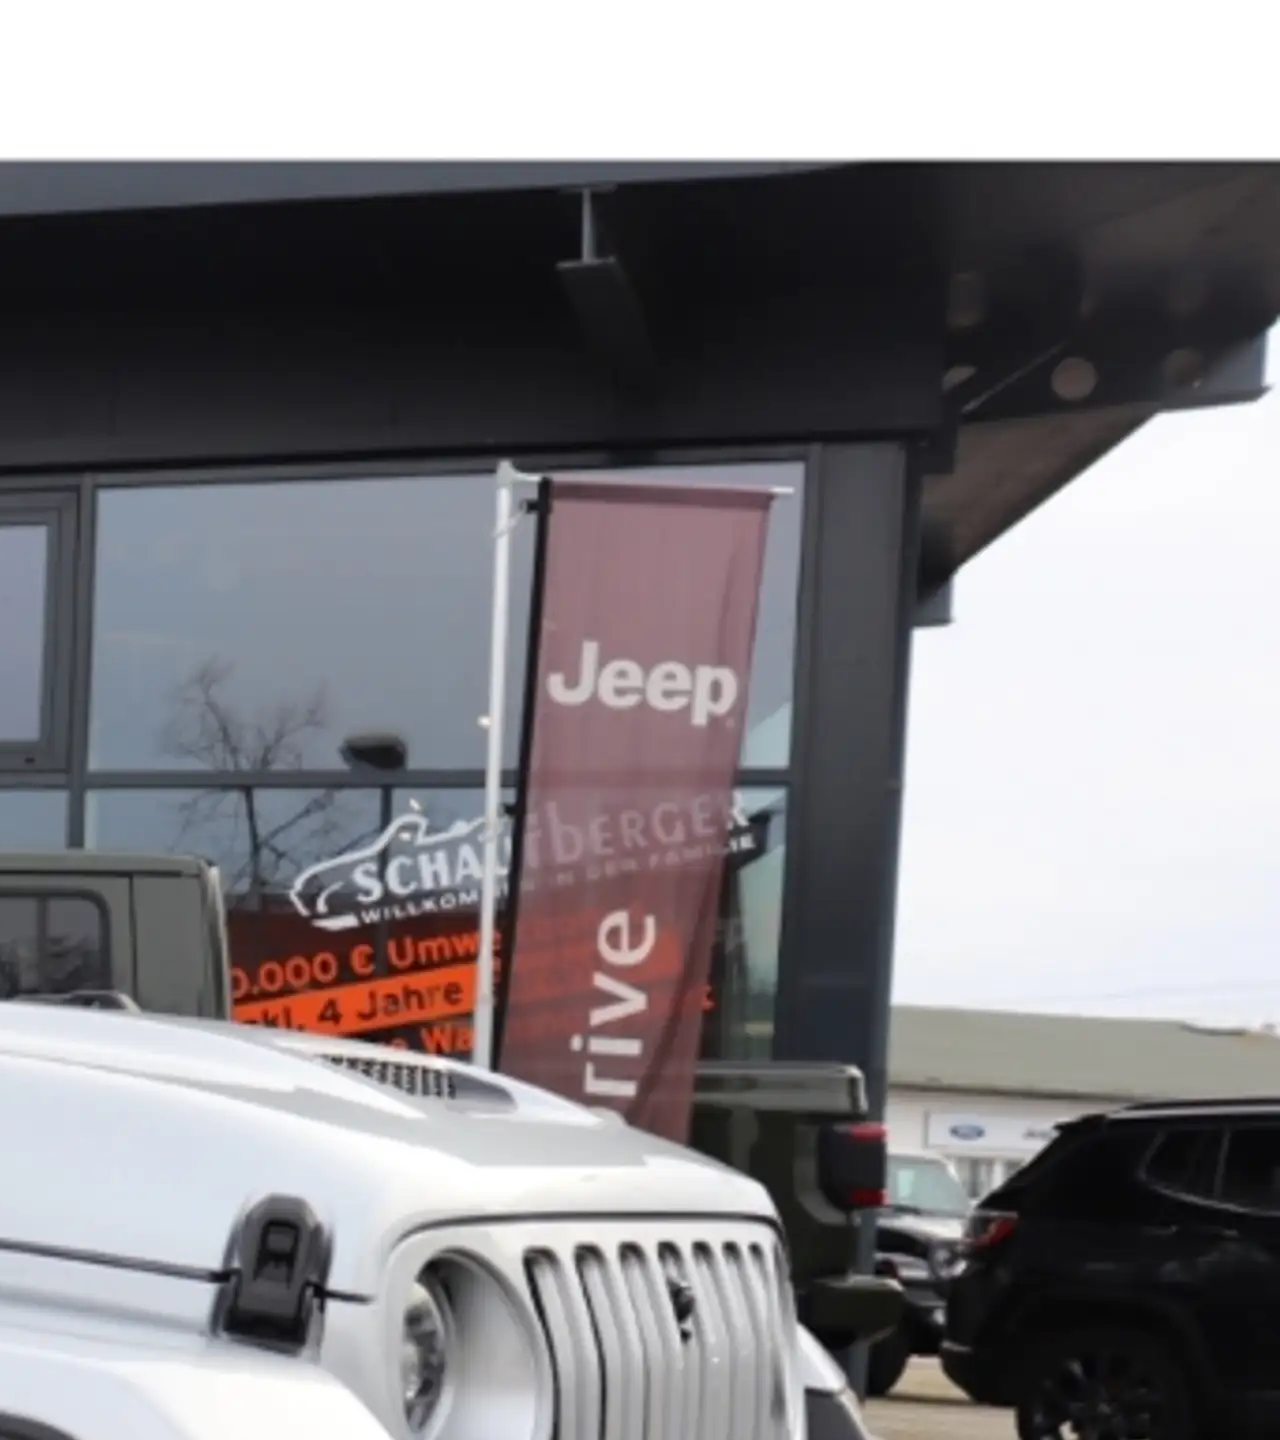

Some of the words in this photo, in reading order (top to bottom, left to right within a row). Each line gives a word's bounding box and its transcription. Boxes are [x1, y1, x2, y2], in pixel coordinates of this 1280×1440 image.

[546, 640, 738, 725] Jeep
[351, 944, 377, 976] €
[317, 999, 343, 1027] 4
[357, 981, 465, 1021] Jahre
